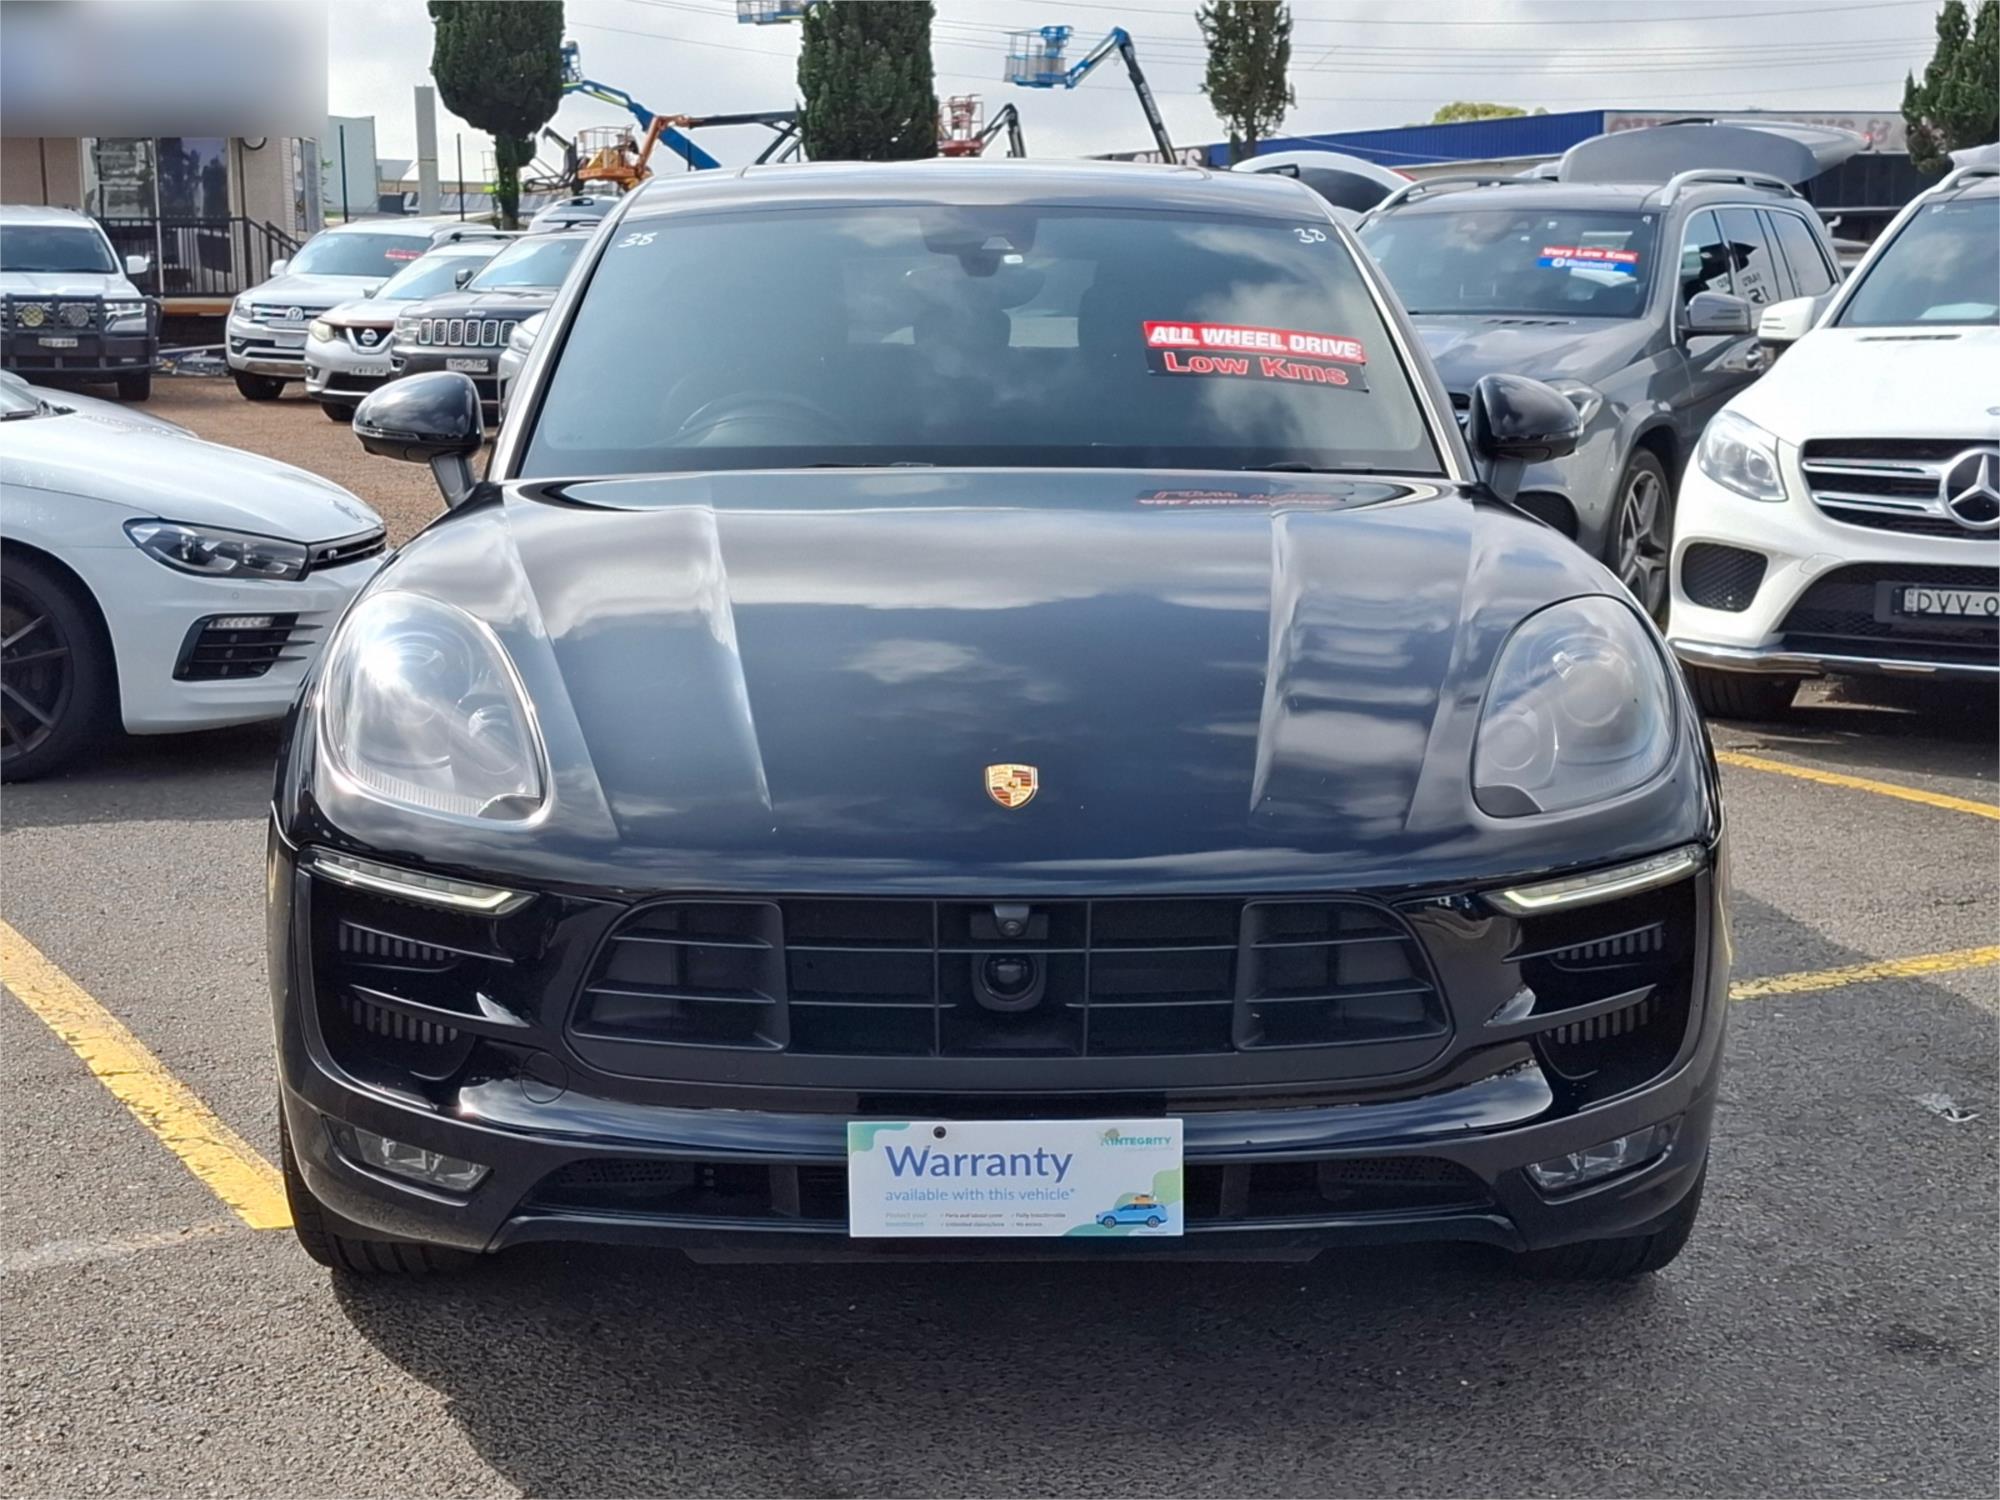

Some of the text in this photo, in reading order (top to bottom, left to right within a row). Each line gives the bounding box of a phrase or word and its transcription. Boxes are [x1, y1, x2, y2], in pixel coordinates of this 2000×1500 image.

[1149, 326, 1363, 359] ALL WHEEL DRIVE
[1163, 352, 1349, 386] Low Kms
[1110, 1136, 1172, 1147] INTEGRITY
[884, 1145, 1074, 1184] Warranty
[885, 1188, 949, 1201] available
[952, 1188, 985, 1201] with
[988, 1188, 1015, 1201] this
